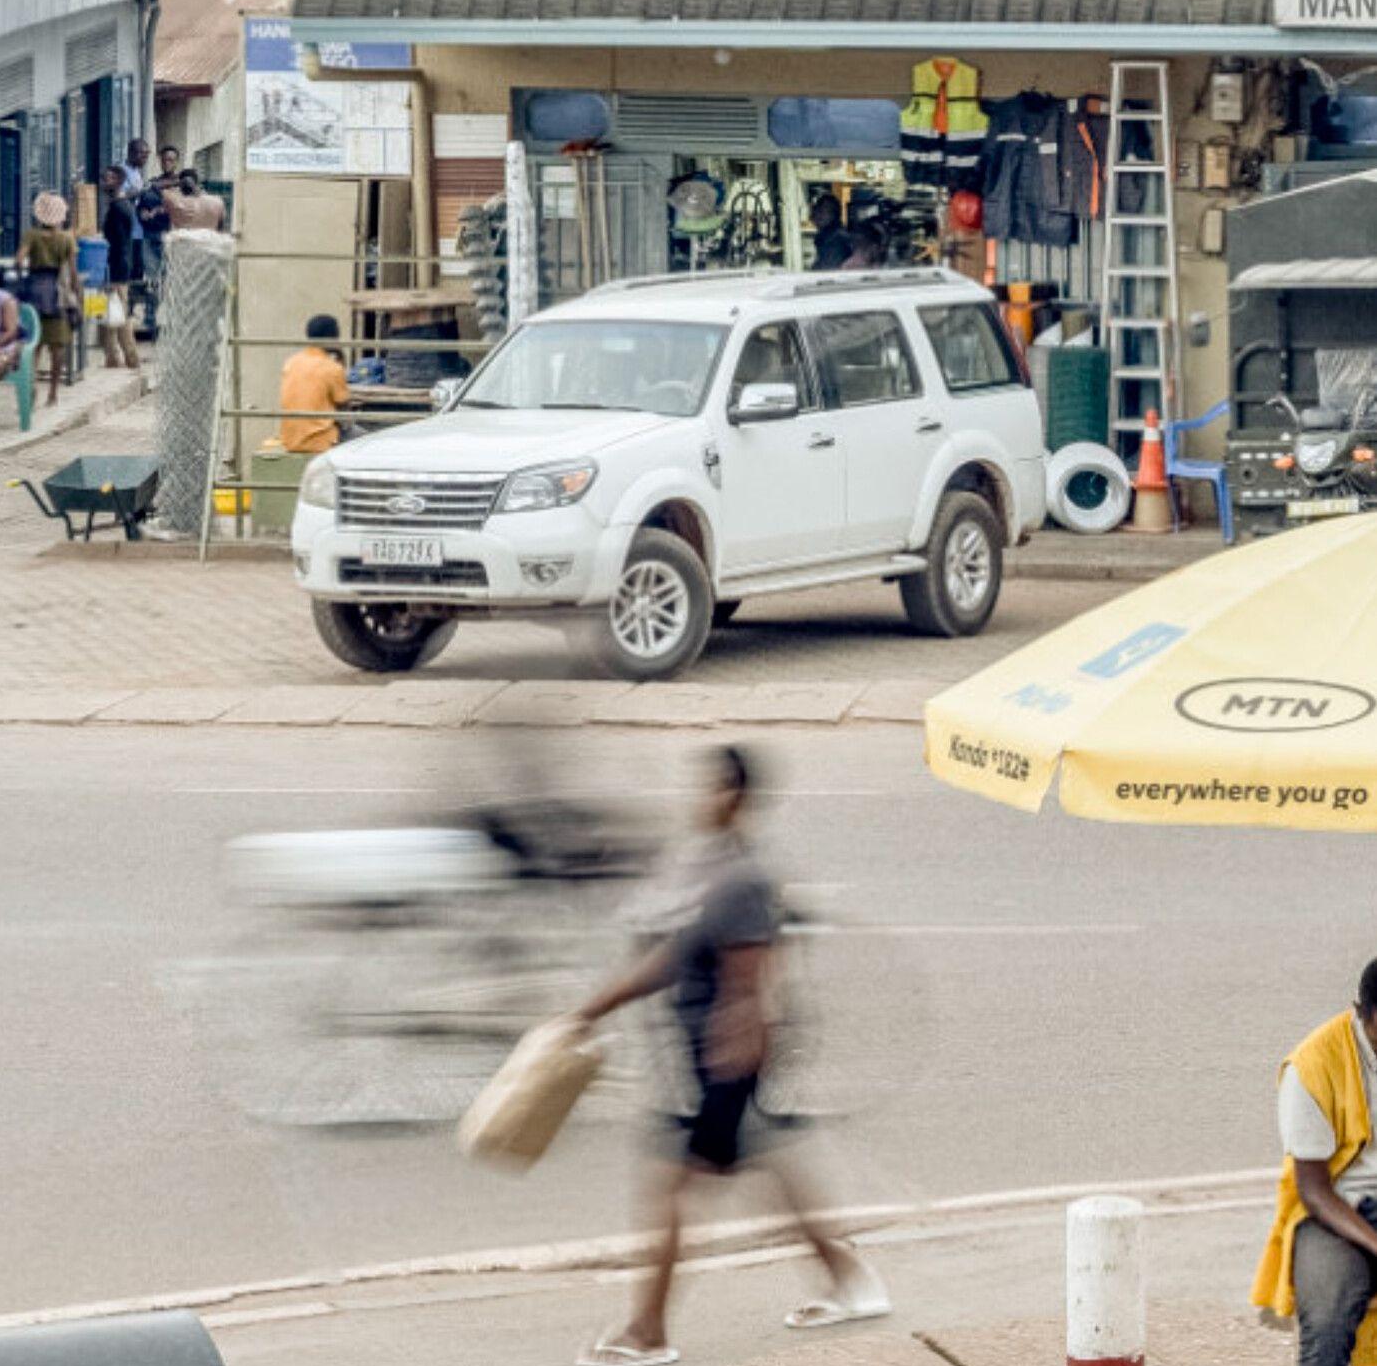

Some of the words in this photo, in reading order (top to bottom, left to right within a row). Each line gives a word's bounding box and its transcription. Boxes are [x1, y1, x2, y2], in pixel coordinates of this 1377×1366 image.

[1222, 694, 1331, 718] MTN
[1115, 778, 1271, 805] everywhere
[1276, 786, 1326, 808] you
[1332, 787, 1368, 810] go
